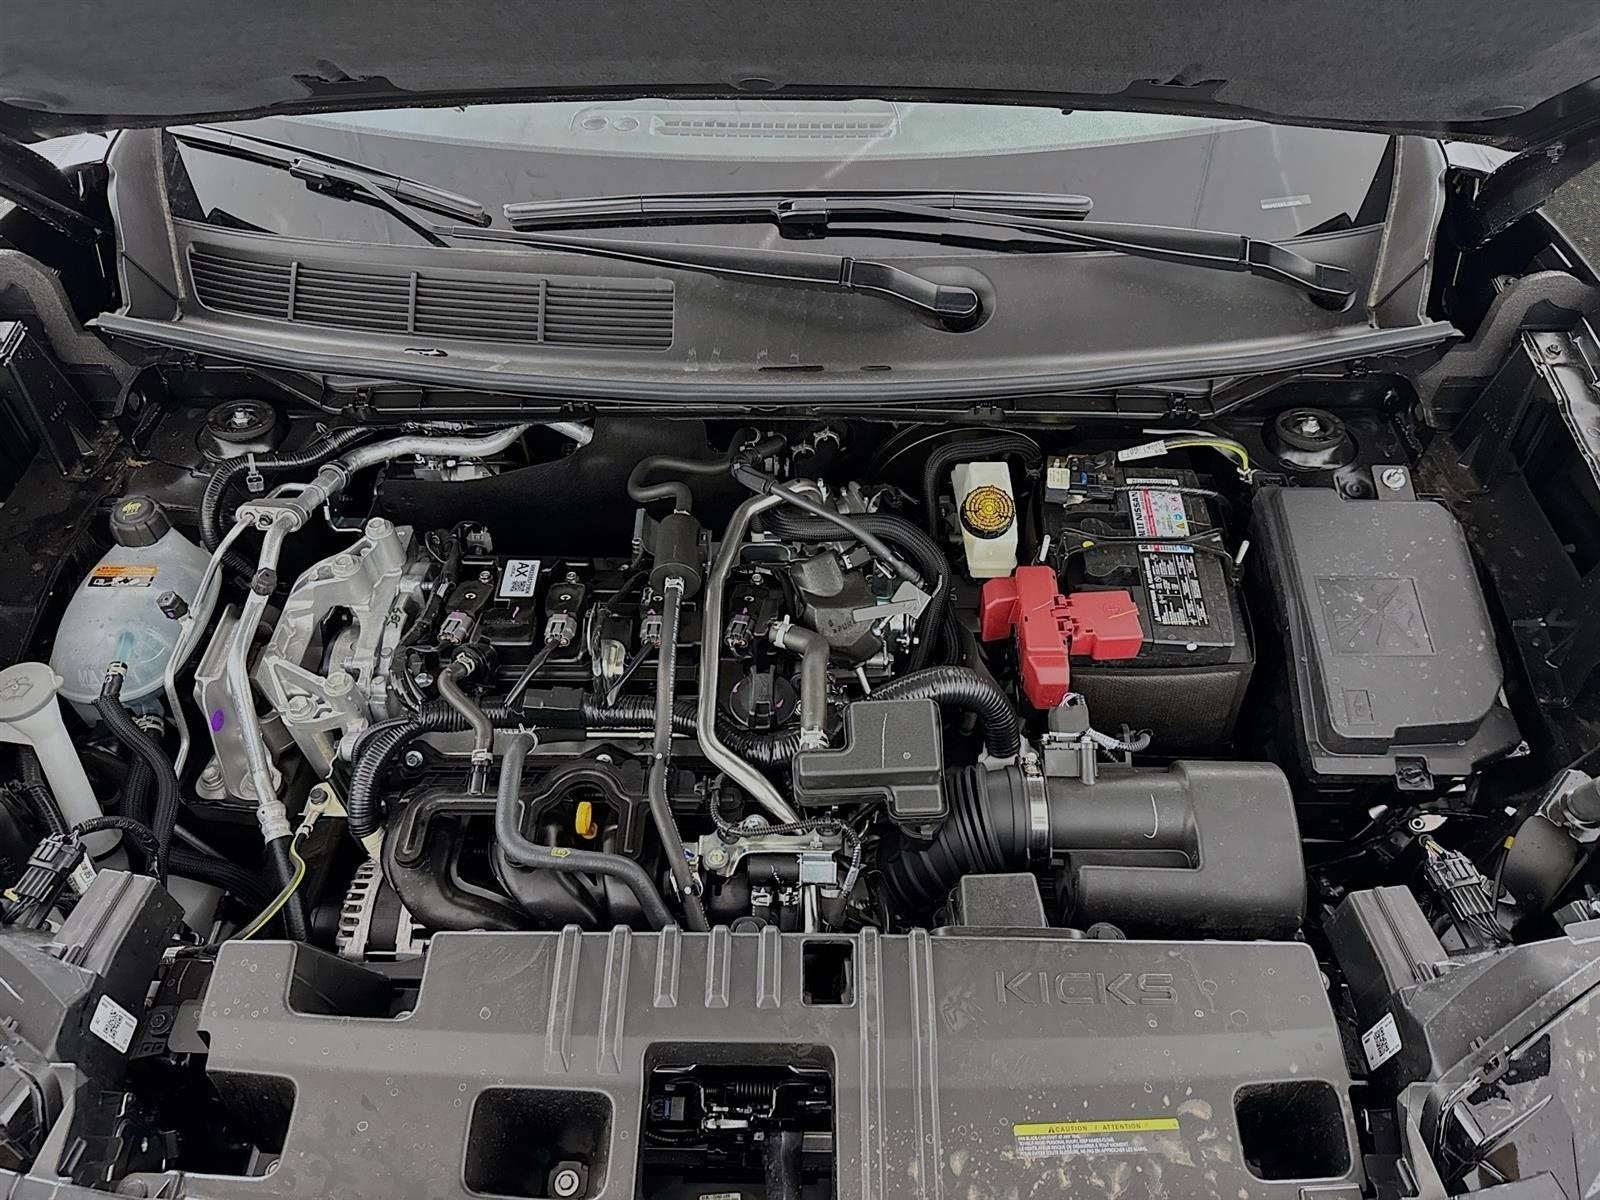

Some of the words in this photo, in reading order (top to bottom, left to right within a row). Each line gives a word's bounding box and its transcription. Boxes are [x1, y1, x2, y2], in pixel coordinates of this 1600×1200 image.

[1131, 491, 1143, 520] NISSAN
[515, 562, 529, 578] AX
[995, 971, 1178, 1006] KICKS
[1055, 1125, 1088, 1133] CAUTION
[1102, 1122, 1141, 1131] ATTENTION
